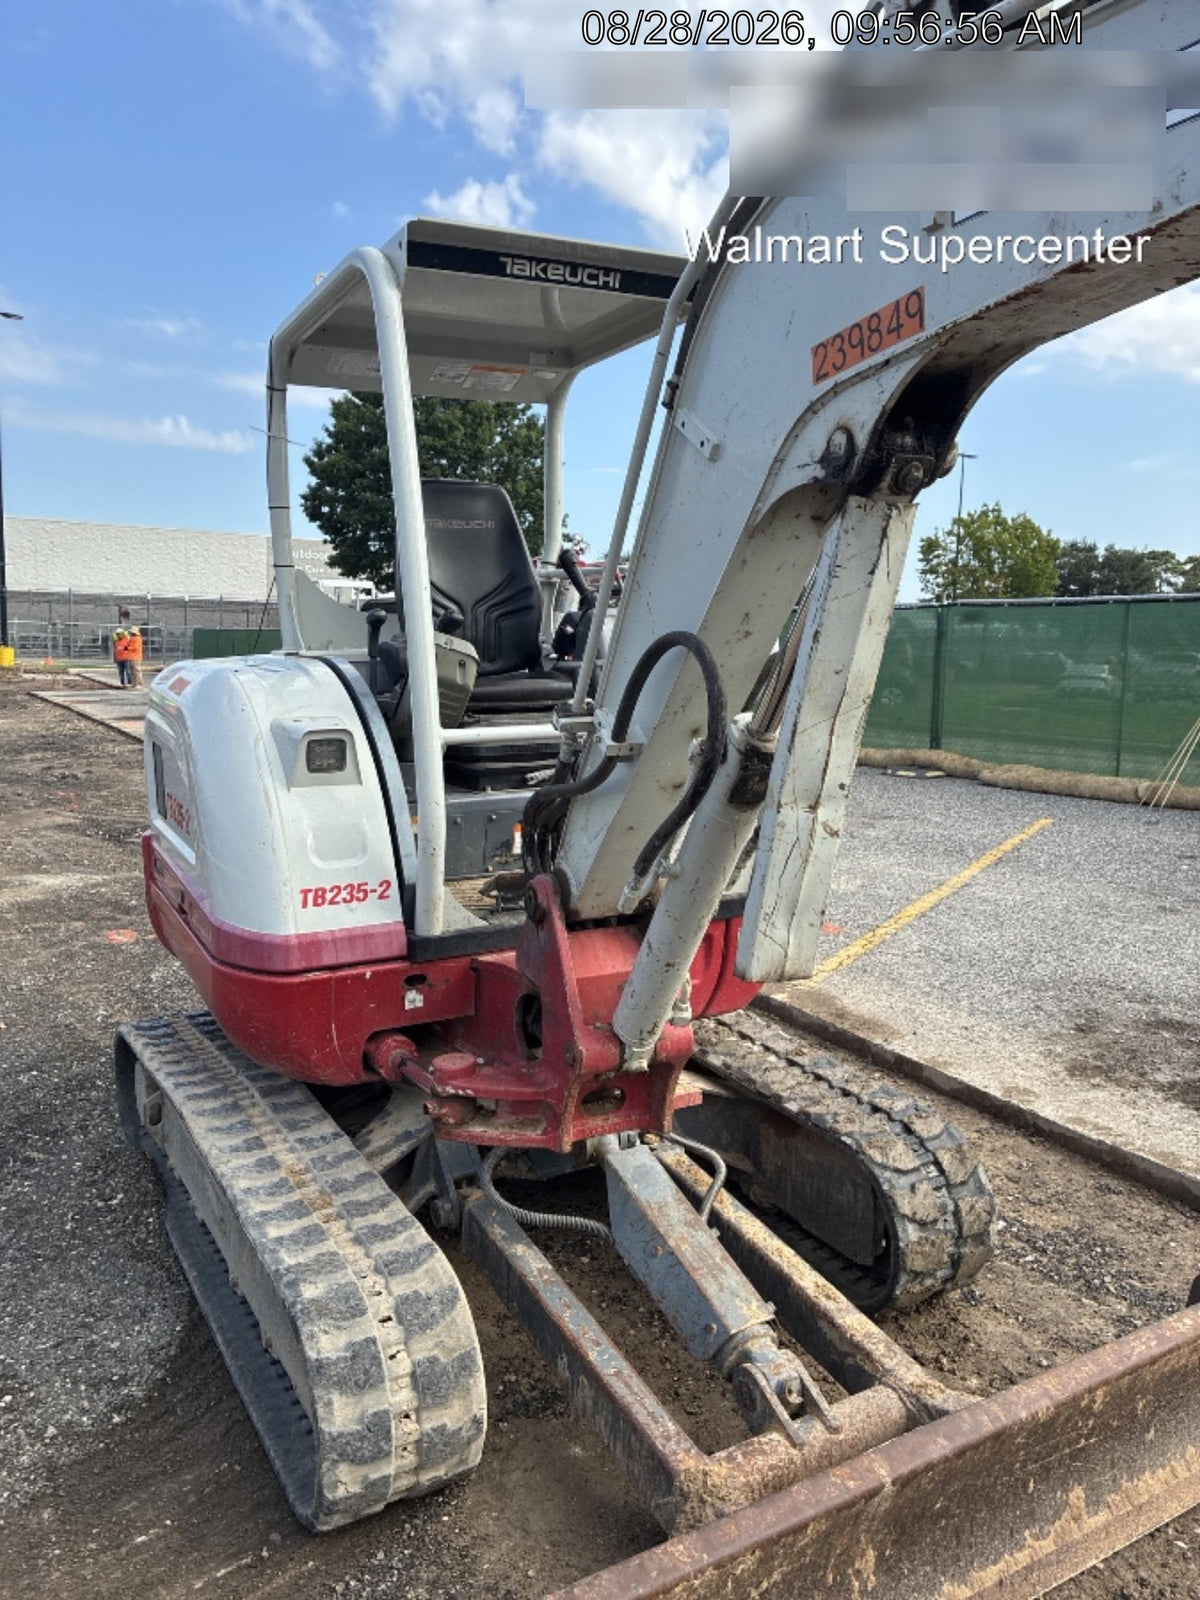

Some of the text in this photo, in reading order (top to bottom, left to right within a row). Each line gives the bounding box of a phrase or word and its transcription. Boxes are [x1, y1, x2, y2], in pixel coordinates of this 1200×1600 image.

[498, 256, 622, 289] TAKEUCHI
[813, 290, 924, 384] 239849
[299, 879, 392, 909] TB235-2
